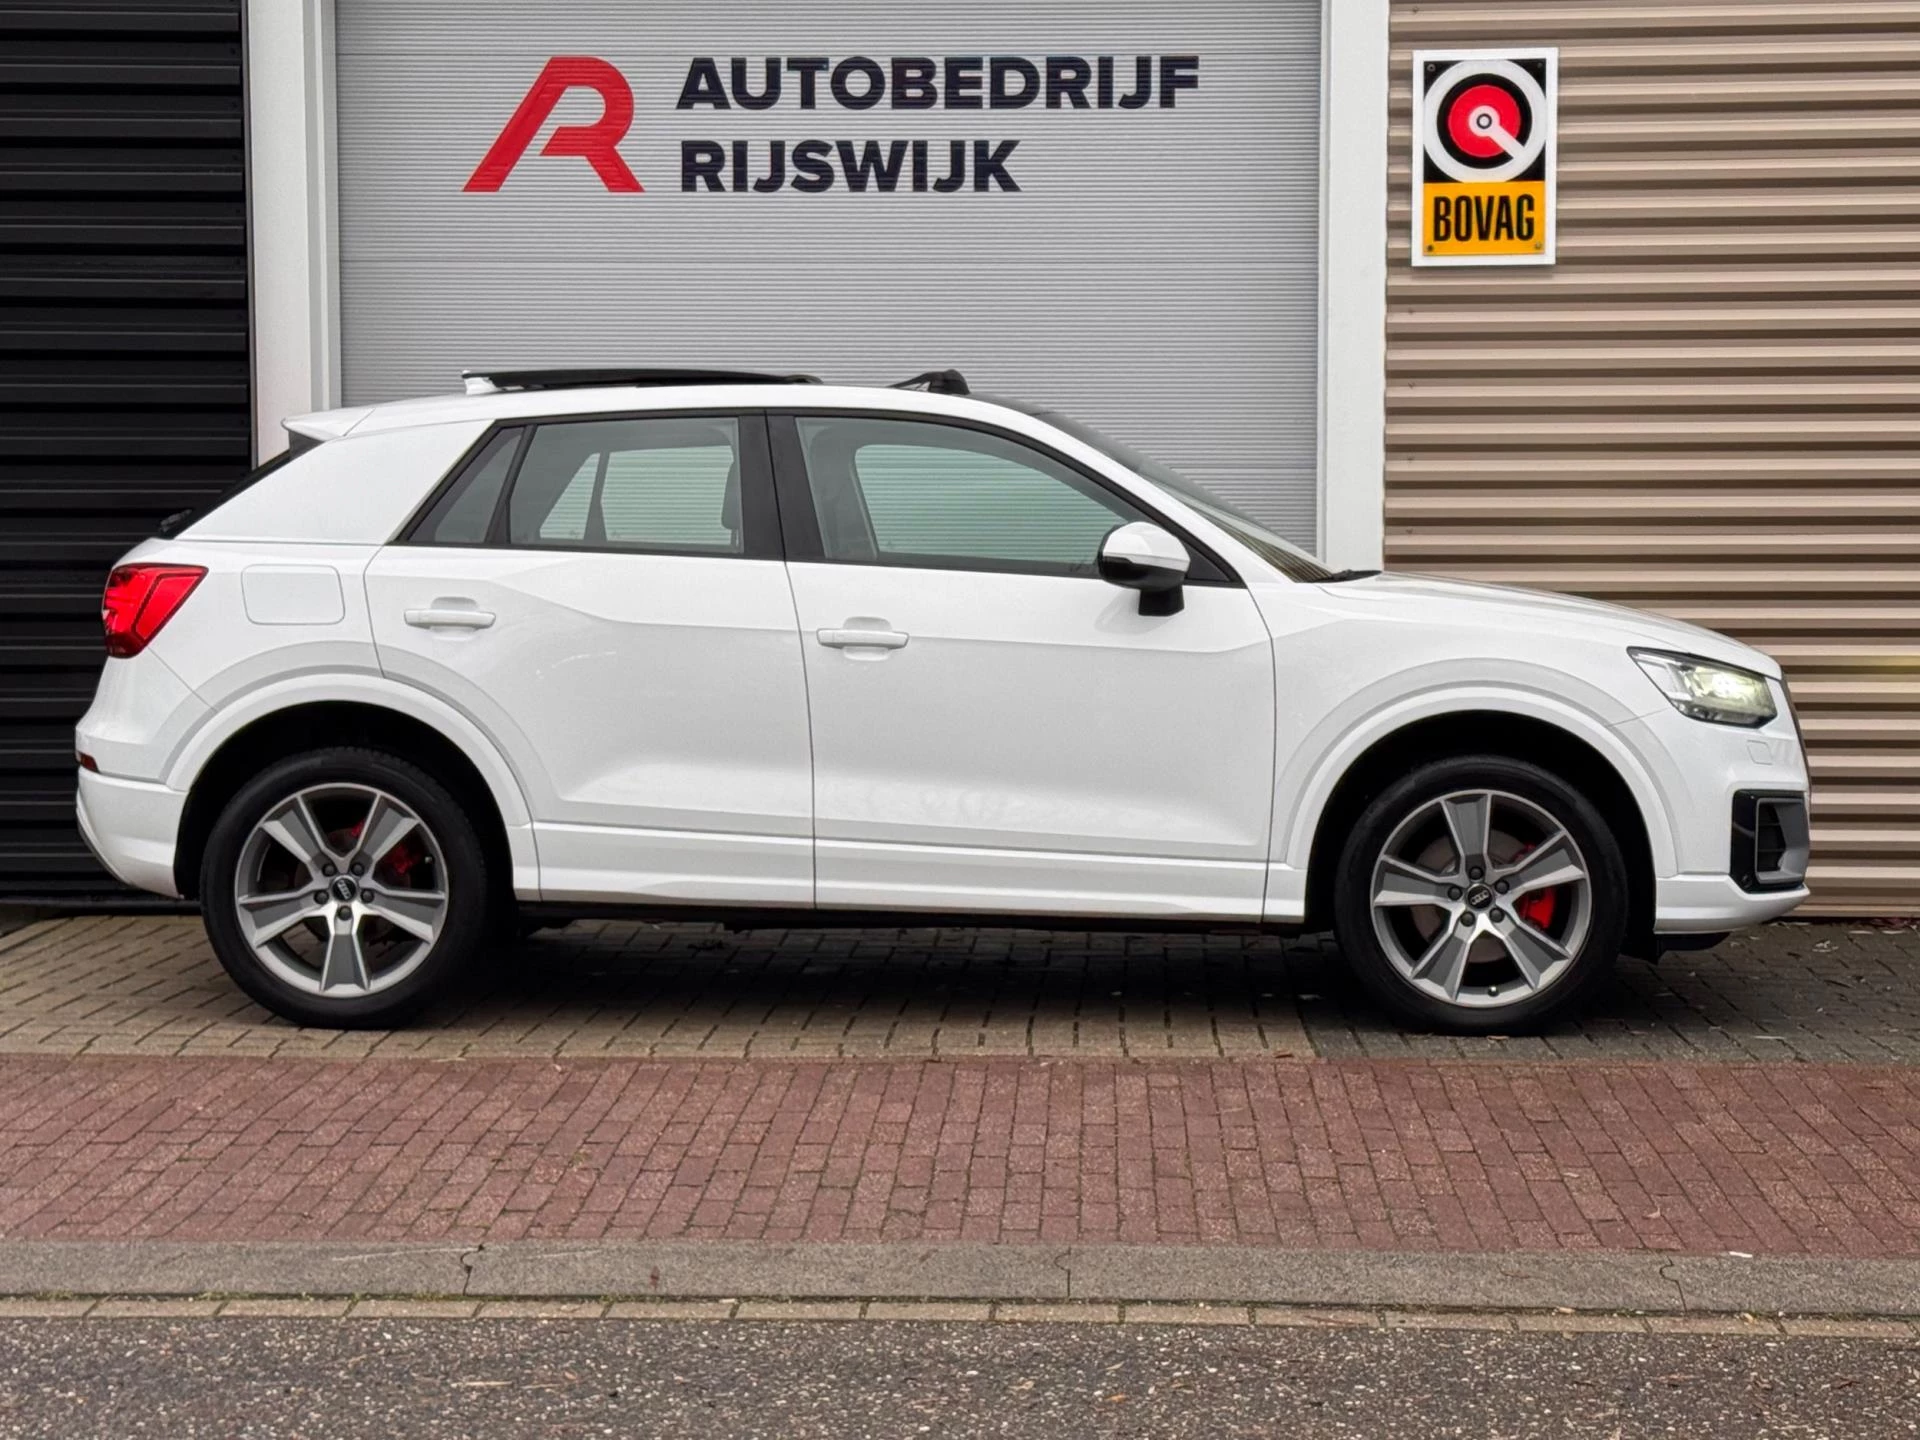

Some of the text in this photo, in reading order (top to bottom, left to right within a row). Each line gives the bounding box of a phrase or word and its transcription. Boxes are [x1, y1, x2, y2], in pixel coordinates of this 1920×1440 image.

[676, 55, 1200, 111] AUTOBEDRIJF
[681, 139, 1021, 193] RIJSWIJK
[1433, 194, 1535, 242] BOVAG
